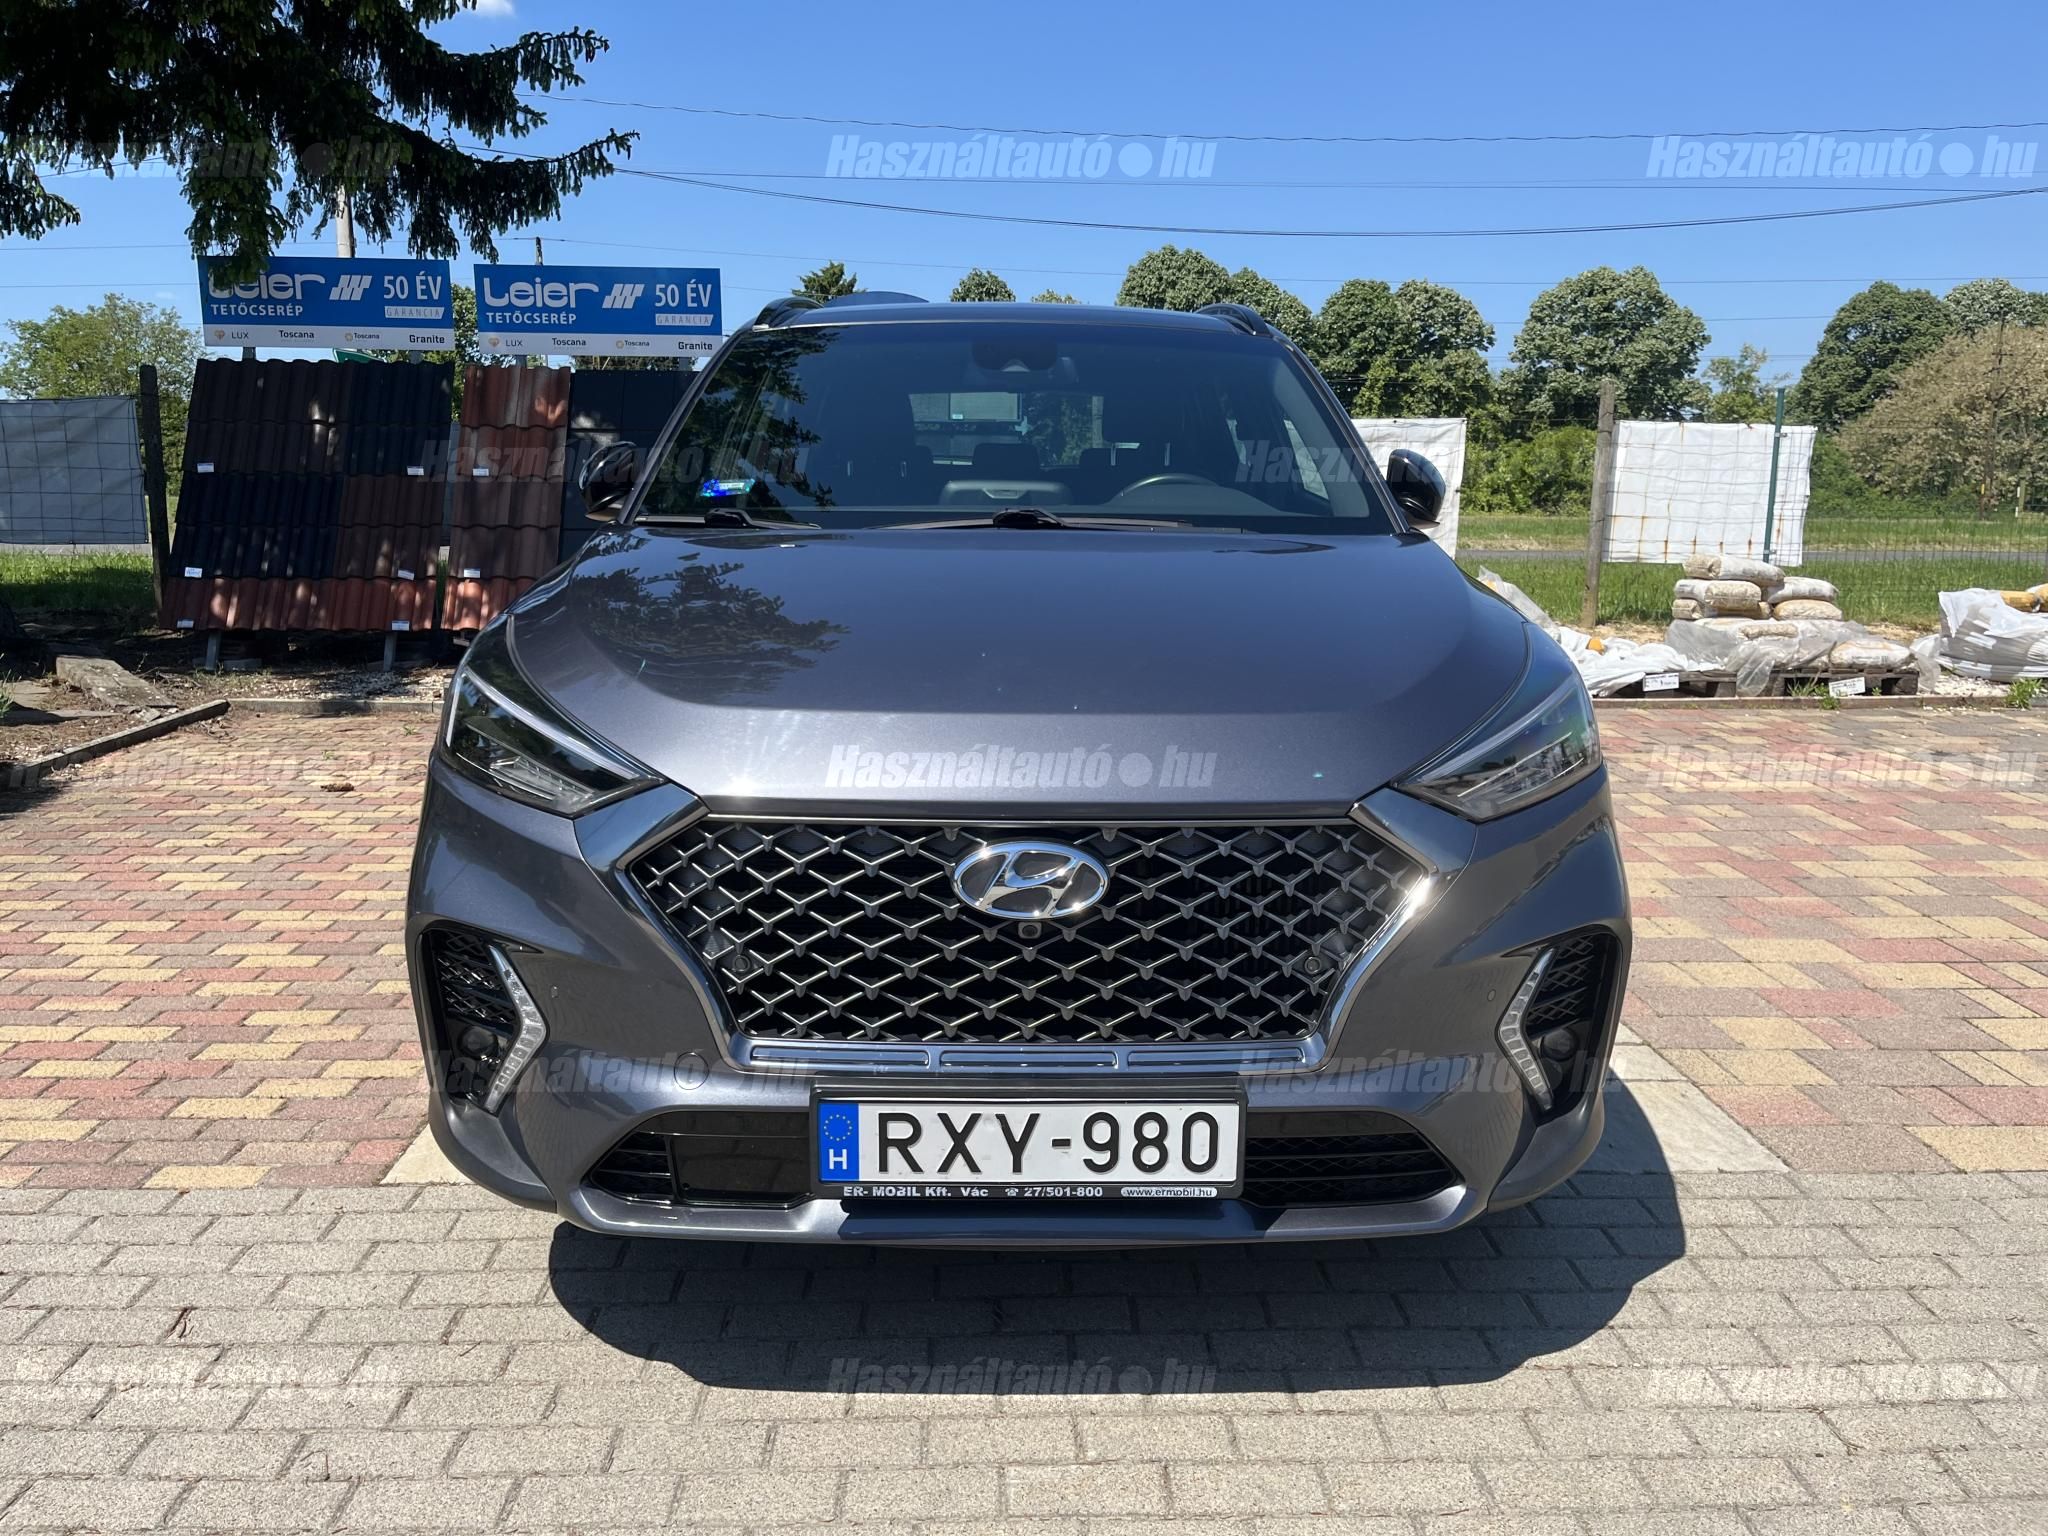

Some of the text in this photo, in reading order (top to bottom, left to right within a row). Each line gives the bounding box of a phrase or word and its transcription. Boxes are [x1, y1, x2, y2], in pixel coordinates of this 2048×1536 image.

[383, 270, 442, 301] 50 ÉV
[483, 277, 600, 308] Leier
[654, 278, 712, 308] 50 ÉV
[211, 302, 304, 317] TETŐCSERÉP
[386, 307, 441, 319] GARANCIA
[486, 311, 577, 325] TETŐCSERÉP
[656, 315, 710, 325] GARANCIA
[231, 329, 445, 344] LUX Toscana Toscana Granite
[505, 337, 713, 351] LUX Toscana Toscana Granite
[877, 1110, 1220, 1174] RXY-980
[828, 1149, 848, 1170] H
[925, 1186, 952, 1197] Kft.
[960, 1186, 989, 1197] Vác
[1024, 1186, 1103, 1197] 27/501-800
